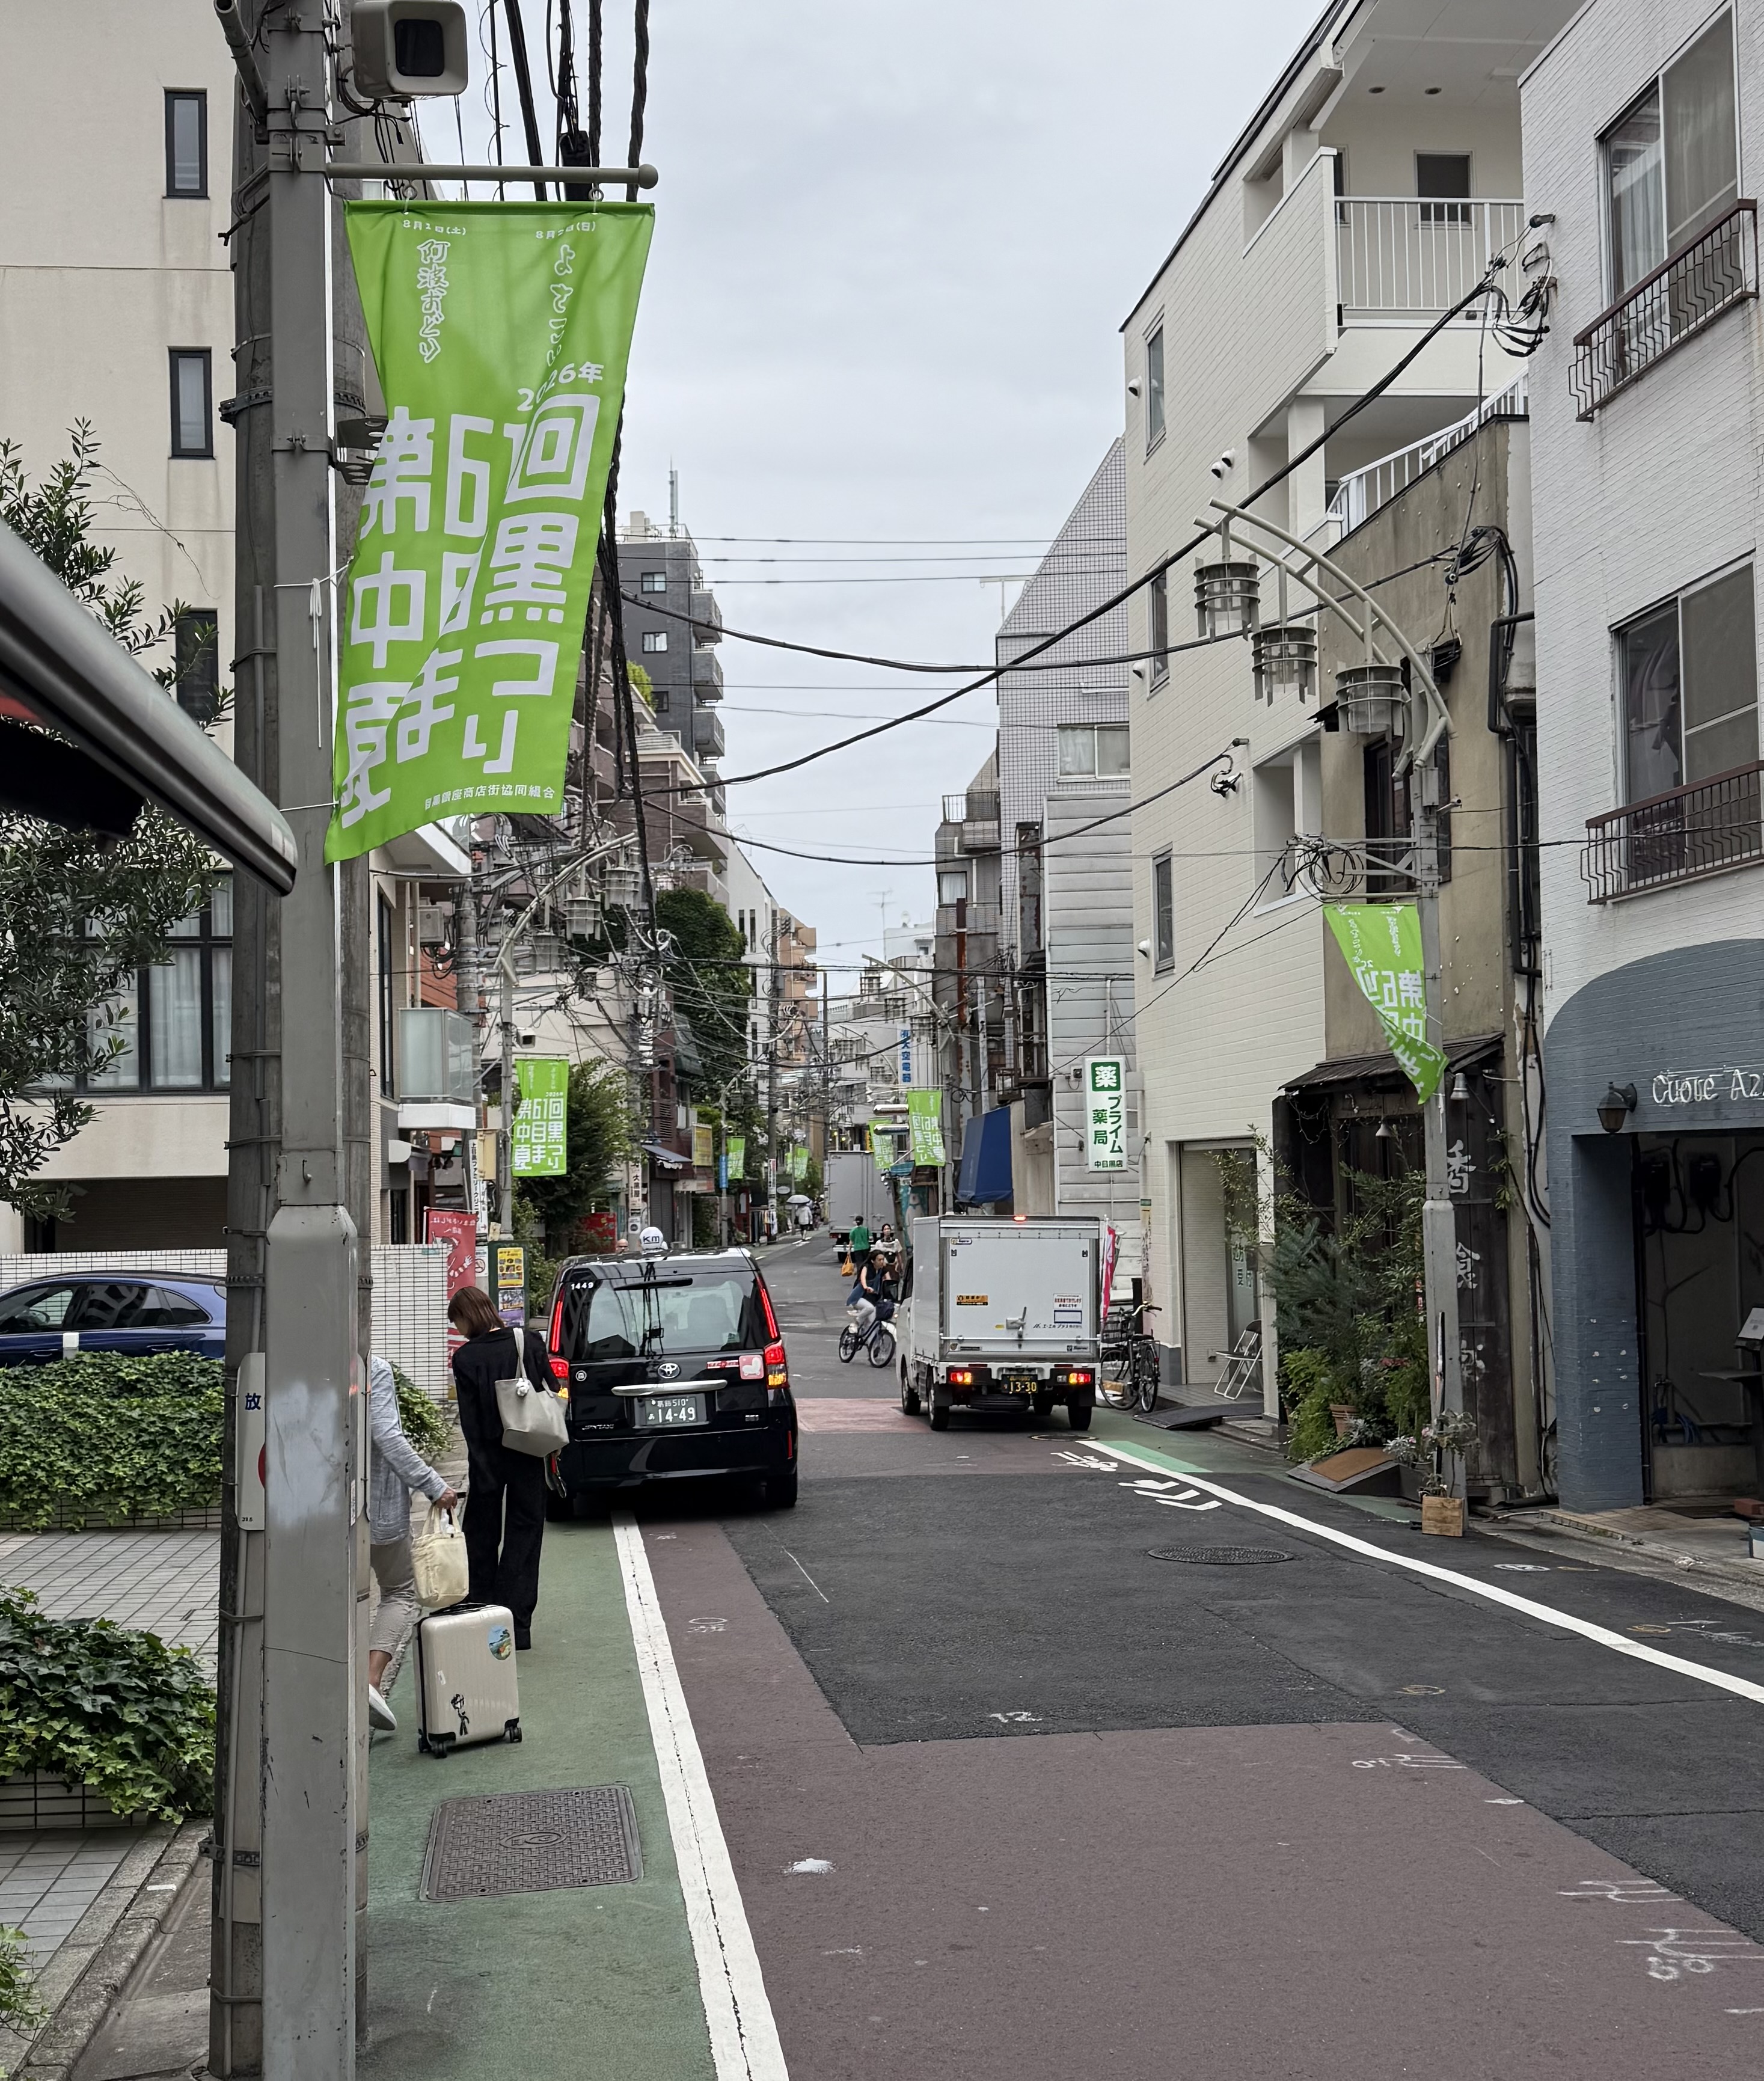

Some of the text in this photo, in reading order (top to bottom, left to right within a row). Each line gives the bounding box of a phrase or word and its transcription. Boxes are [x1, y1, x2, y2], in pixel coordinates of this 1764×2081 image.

[417, 239, 451, 363] 阿波おどり
[518, 361, 604, 411] 2026年
[351, 512, 580, 669] 中目黒
[341, 639, 559, 829] 夏まつり
[1095, 1065, 1117, 1088] 薬
[1730, 1069, 1764, 1101] Az
[517, 1097, 564, 1120] 第61回
[516, 1121, 563, 1143] 中目黒
[1092, 1109, 1107, 1145] 薬局
[1109, 1095, 1123, 1153] プライム
[514, 1144, 563, 1170] 夏まつり
[1010, 1382, 1037, 1392] 13-30
[245, 1393, 262, 1411] 放
[658, 1407, 696, 1423] 14-49
[672, 1399, 686, 1407] 510
